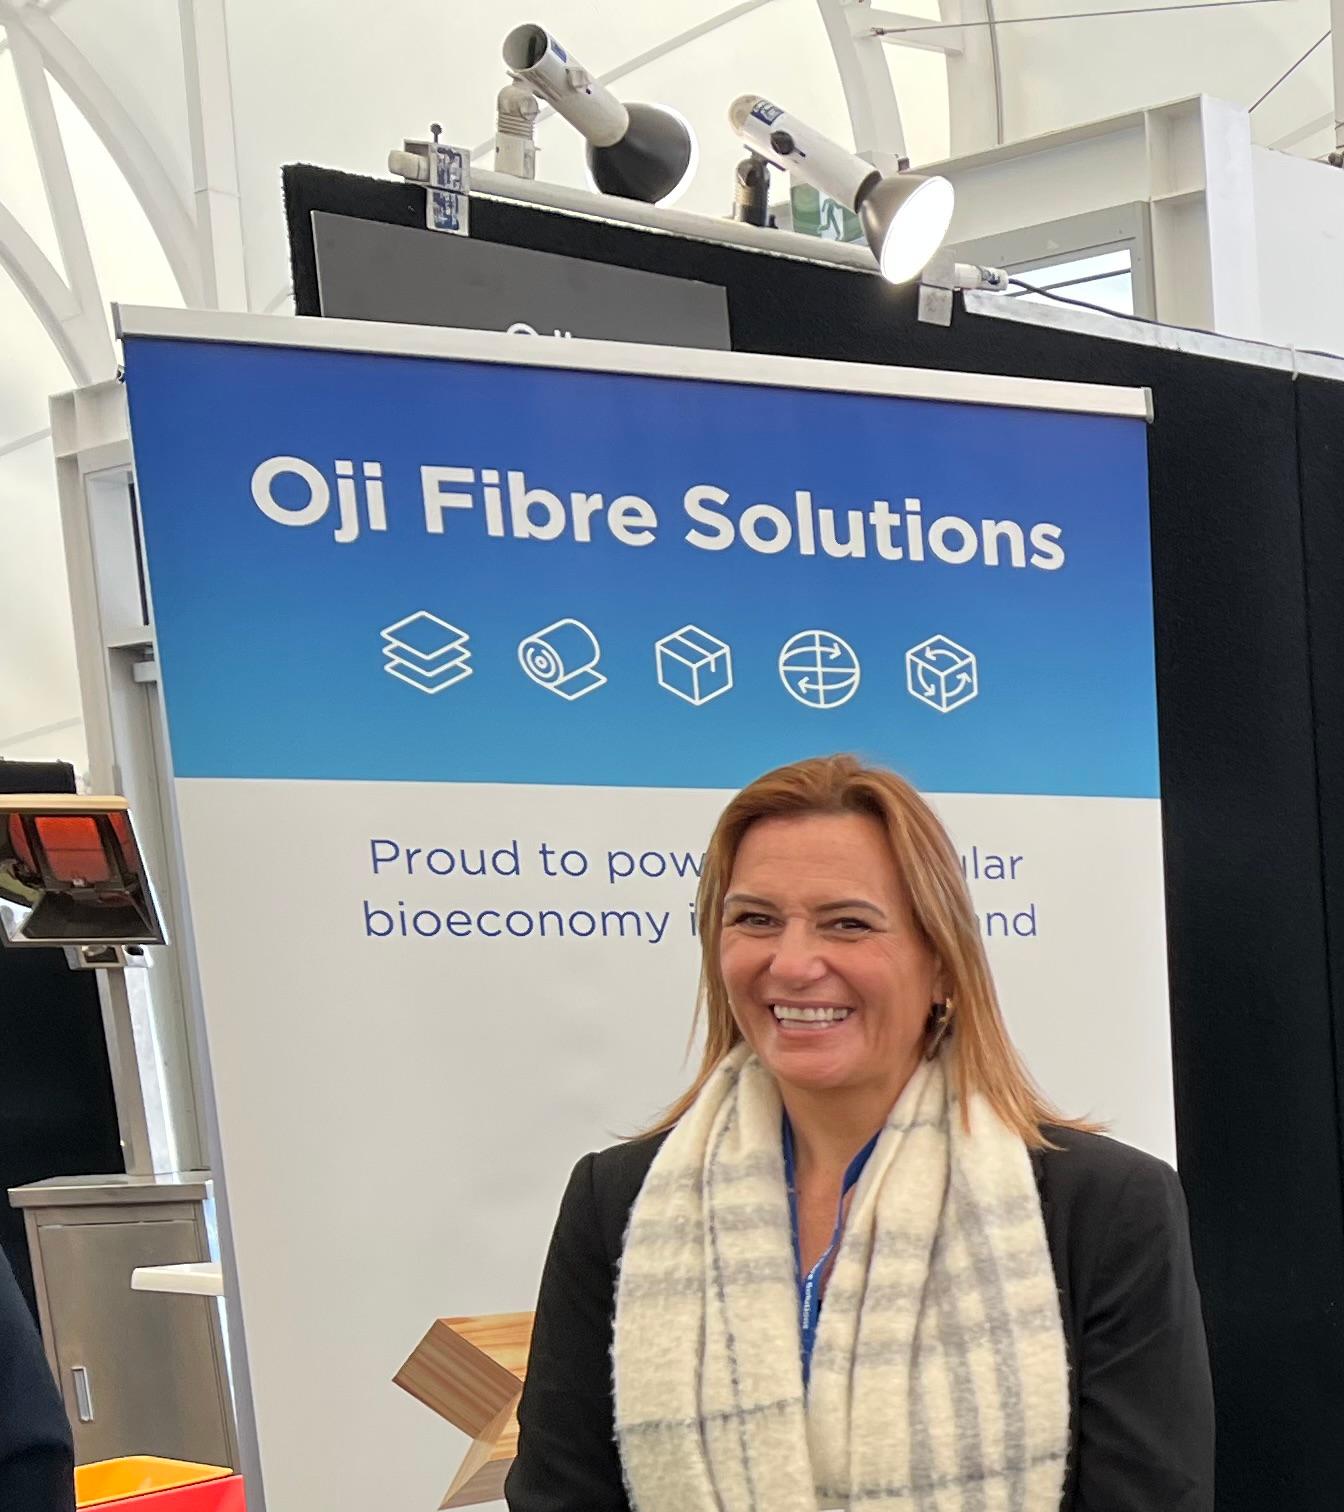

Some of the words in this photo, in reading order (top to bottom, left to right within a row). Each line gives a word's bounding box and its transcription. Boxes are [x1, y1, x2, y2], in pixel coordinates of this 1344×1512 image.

[249, 454, 388, 544] Oji
[420, 464, 658, 548] Fibre
[684, 484, 1066, 572] Solutions
[370, 839, 520, 876] Proud
[539, 843, 588, 876] to
[608, 851, 706, 884] pow
[962, 845, 1024, 880] lar
[363, 900, 670, 944] bioeconomy
